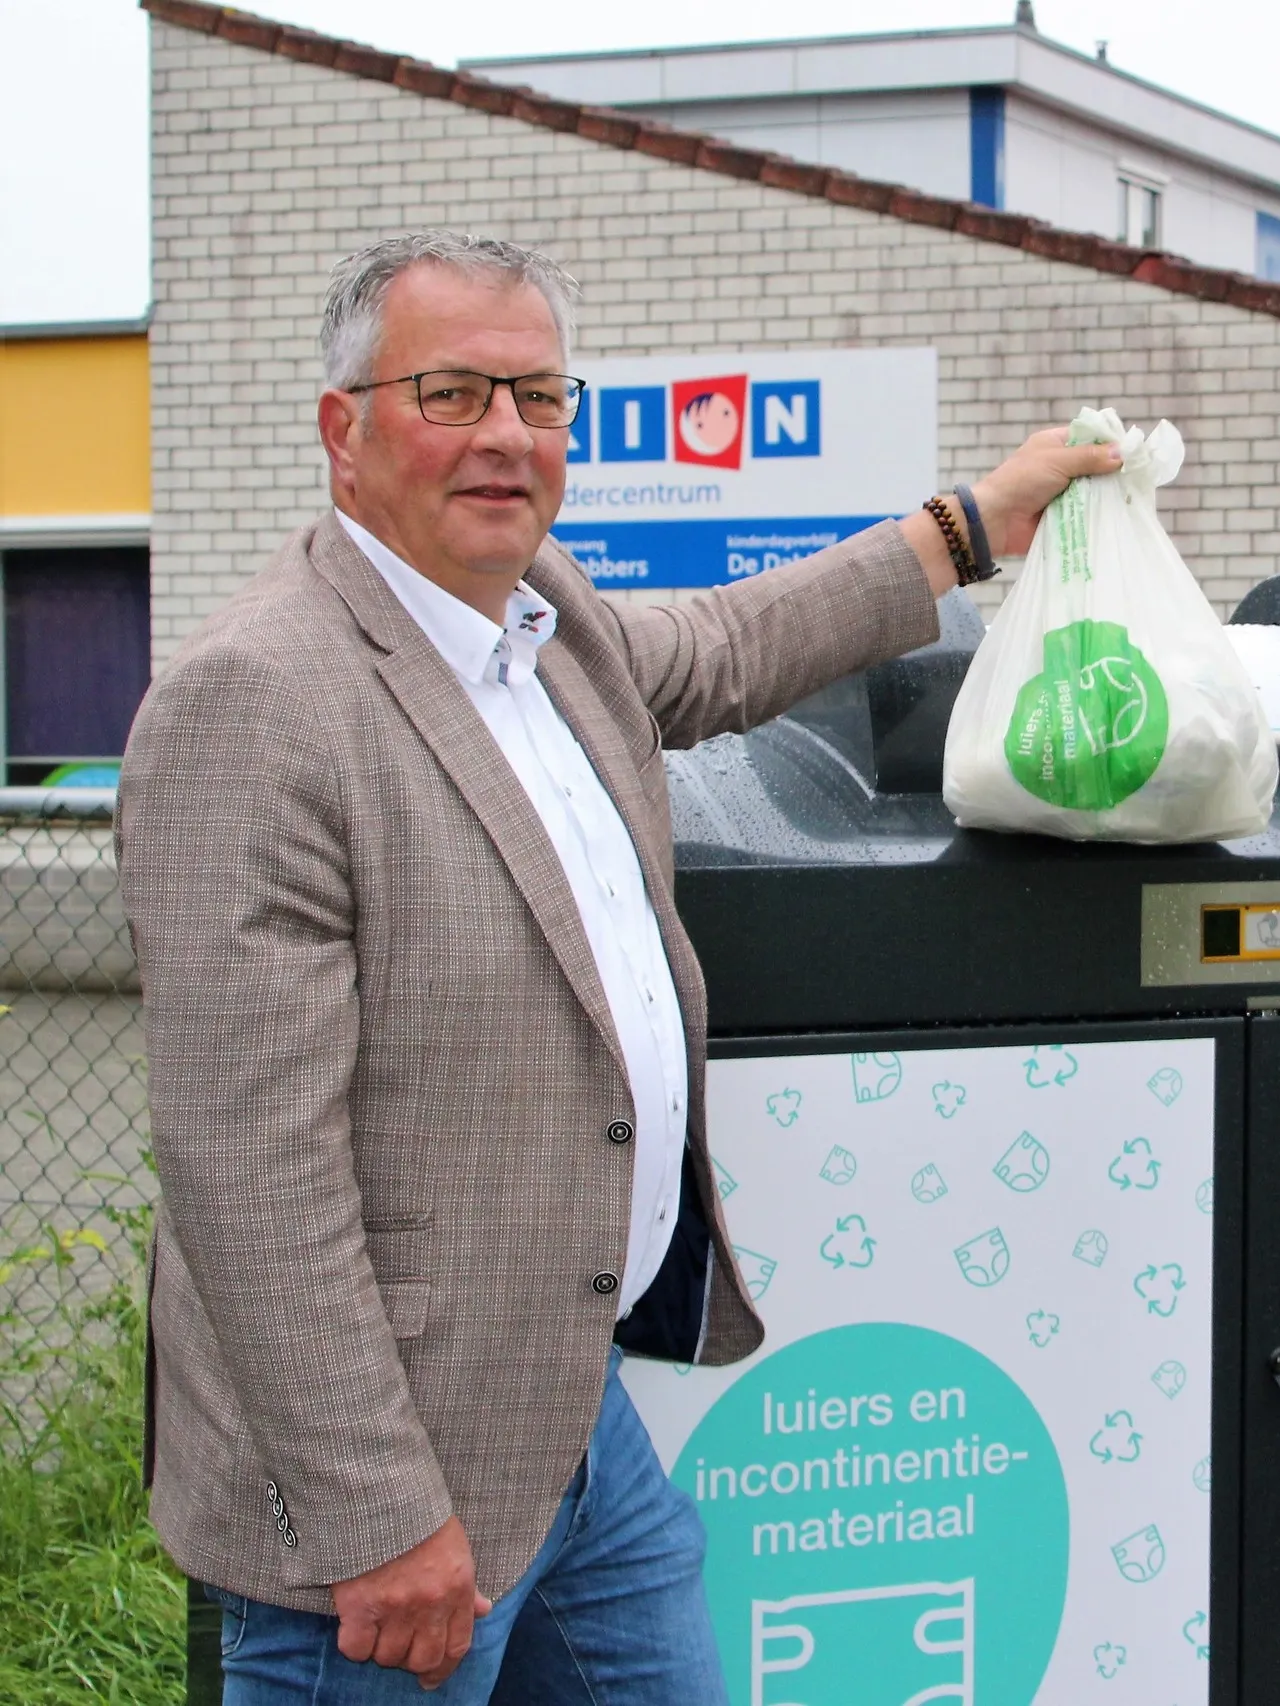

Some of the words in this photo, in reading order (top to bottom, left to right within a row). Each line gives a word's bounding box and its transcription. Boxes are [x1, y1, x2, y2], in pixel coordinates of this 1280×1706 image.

[567, 392, 808, 457] ION
[564, 481, 721, 507] dercentrum
[727, 552, 759, 576] De
[1018, 708, 1043, 755] luiers
[1053, 679, 1077, 759] materiaal
[763, 1388, 893, 1435] luiers
[909, 1387, 966, 1422] en
[696, 1434, 1029, 1501] incontinentie-
[753, 1494, 975, 1556] materiaal
